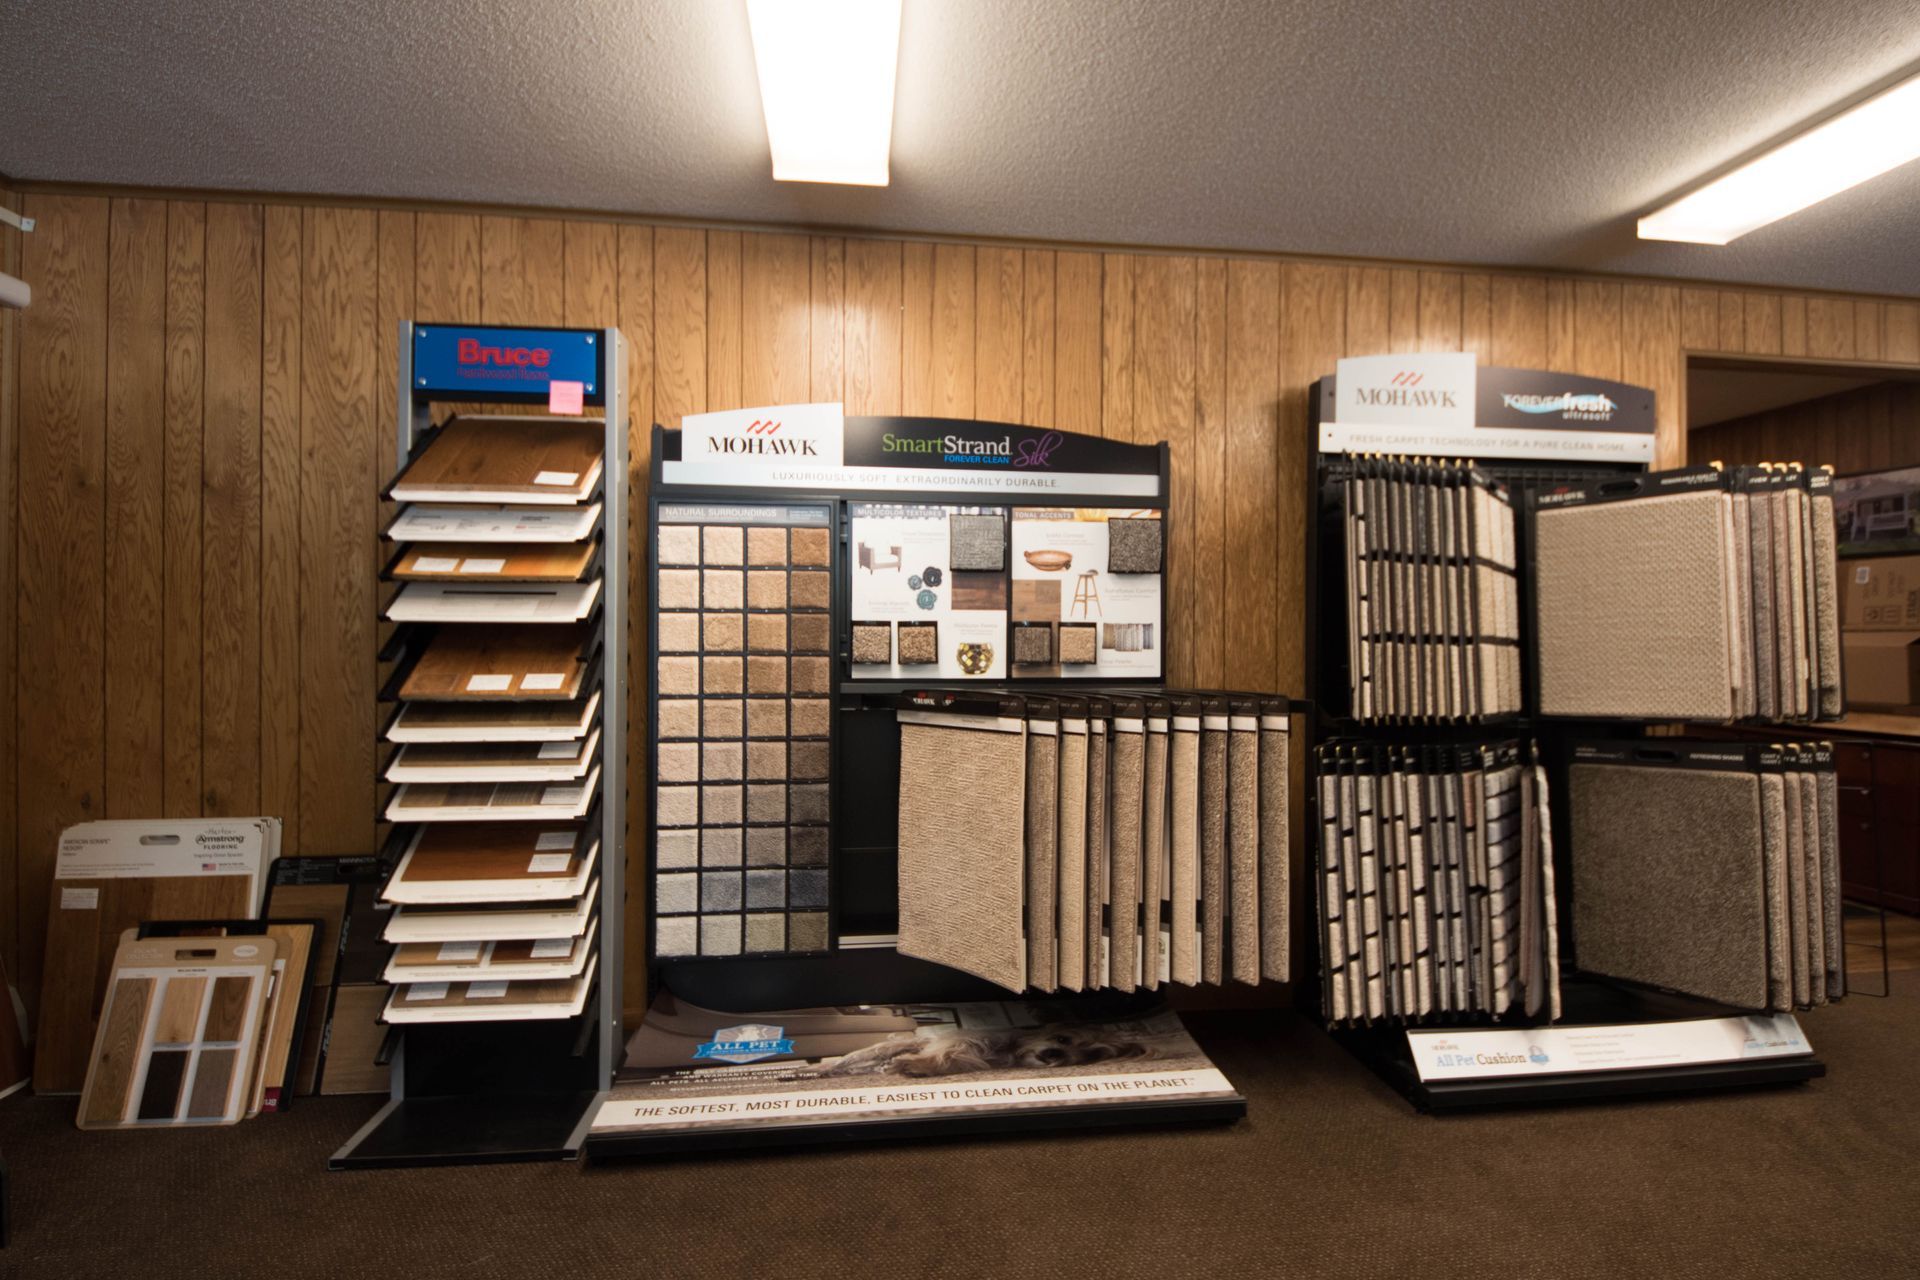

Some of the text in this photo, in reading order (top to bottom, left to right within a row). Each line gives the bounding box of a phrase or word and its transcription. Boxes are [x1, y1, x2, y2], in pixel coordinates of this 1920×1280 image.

[457, 338, 550, 367] Bruce
[1355, 388, 1457, 408] MOHAWK
[707, 435, 818, 457] MOHAWK
[882, 433, 1012, 456] SmartStrand
[1014, 431, 1064, 467] Silk
[1350, 434, 1624, 452] FRESH CARPET TECHNOLOGY FOR A PURE CLEAN HOME
[944, 455, 1010, 465] FOREVER CLEAN
[772, 471, 855, 482] LUXURIOUSLY
[896, 474, 1002, 487] EXTRAORDINARILY
[665, 507, 705, 517] NATURAL
[708, 508, 777, 518] SURROUNDINGS
[857, 508, 943, 517] MULTICOLOR TEXTURES
[1014, 511, 1038, 519] TONAL
[195, 834, 244, 846] Armstrong
[712, 1041, 746, 1051] ALL
[749, 1039, 781, 1049] PET
[1436, 1051, 1527, 1067] All Pet Cushion
[634, 1107, 663, 1117] THE
[668, 1103, 740, 1116] SOFTEST,
[746, 1100, 790, 1112] MOST
[796, 1095, 871, 1109] DURABLE,
[877, 1091, 936, 1103] EASIEST
[942, 1090, 960, 1100] TO
[965, 1086, 1013, 1098] CLEAN
[1017, 1083, 1073, 1096] CARPET
[1077, 1082, 1098, 1092] ON
[1104, 1080, 1130, 1091] THE
